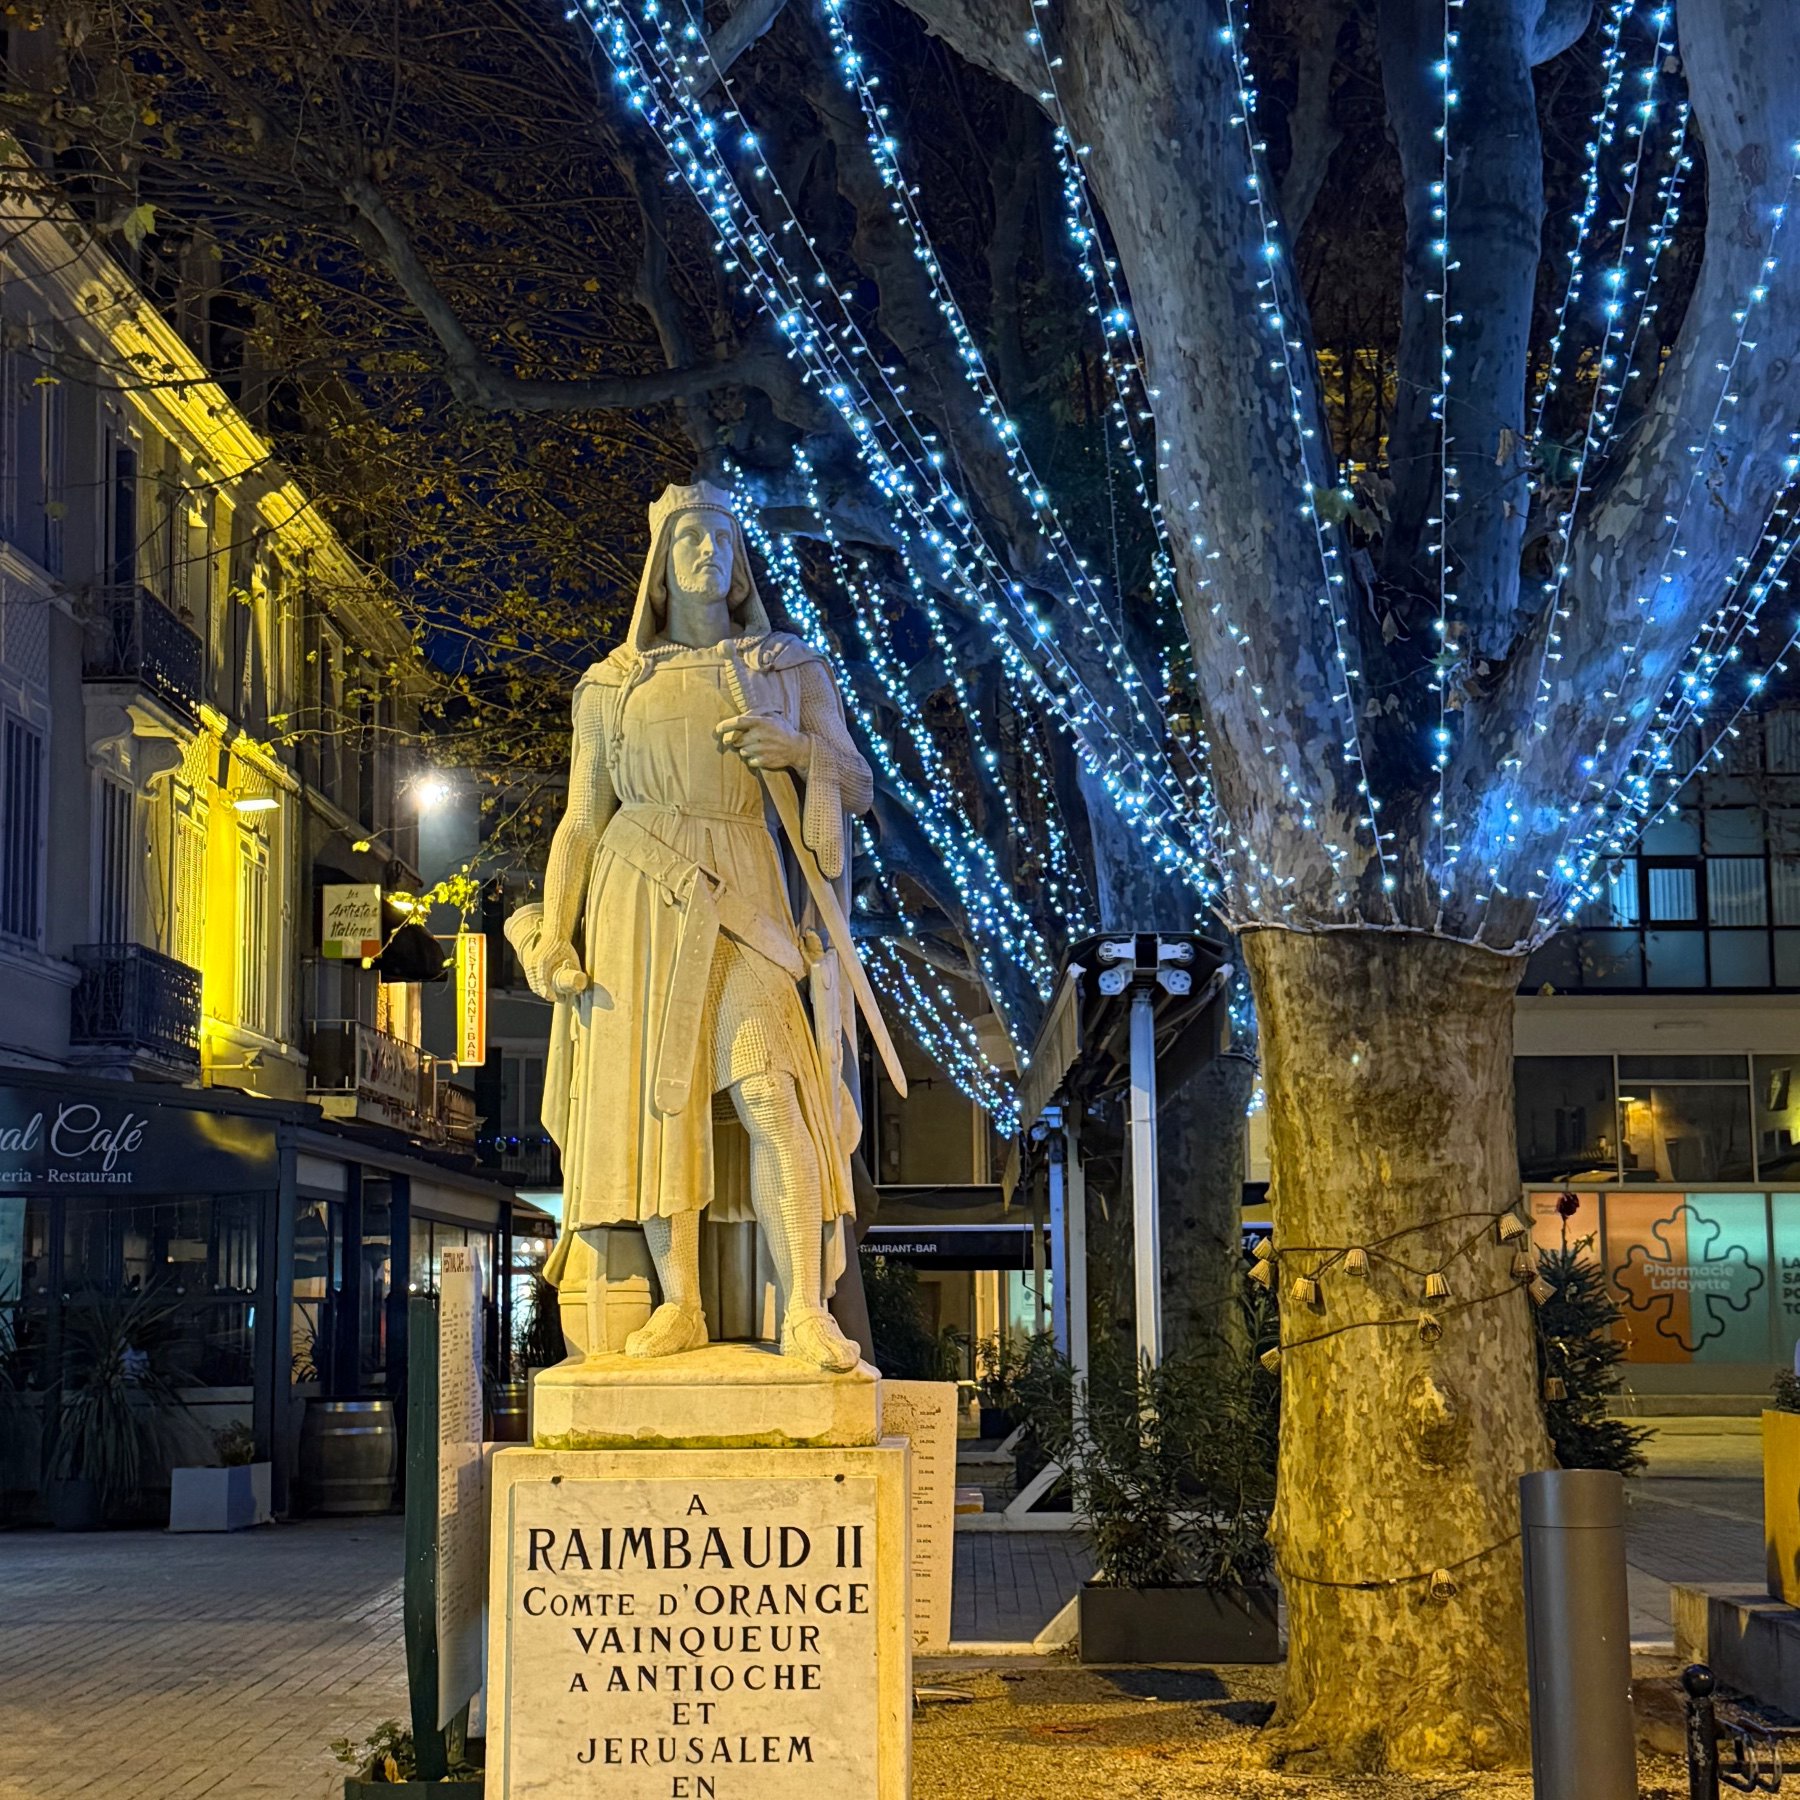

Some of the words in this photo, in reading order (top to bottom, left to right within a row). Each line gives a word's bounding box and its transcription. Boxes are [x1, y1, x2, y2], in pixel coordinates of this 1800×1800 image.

[50, 1102, 148, 1172] Café
[48, 1168, 132, 1183] Restaurant
[1643, 1264, 1734, 1277] Pharmacie
[1651, 1278, 1731, 1292] Lafayette
[687, 1494, 708, 1516] A
[527, 1525, 811, 1575] RAIMBAUD
[836, 1525, 864, 1568] II
[572, 1625, 821, 1658] VAINQUEUR
[568, 1673, 589, 1693] A
[606, 1664, 822, 1692] ANTIOCHE
[672, 1702, 716, 1726] ET
[577, 1736, 815, 1767] JERUSALEM
[672, 1776, 716, 1799] EN
